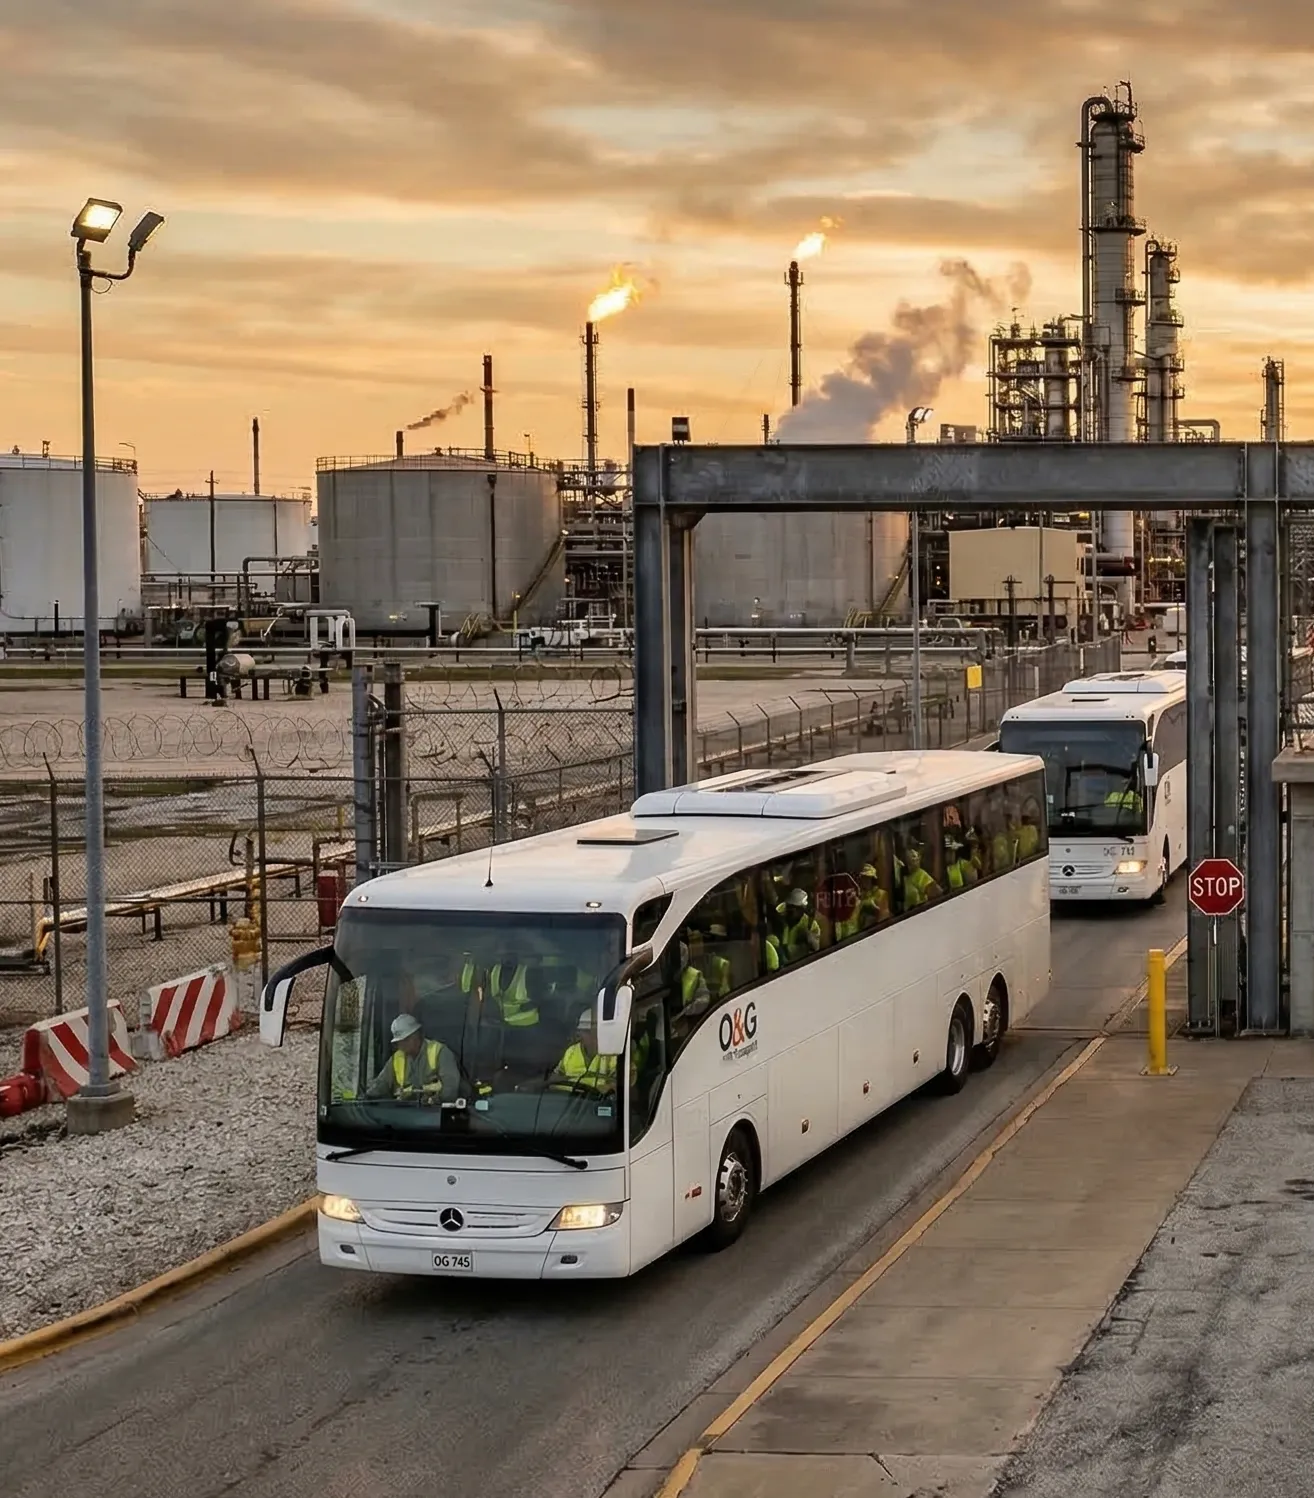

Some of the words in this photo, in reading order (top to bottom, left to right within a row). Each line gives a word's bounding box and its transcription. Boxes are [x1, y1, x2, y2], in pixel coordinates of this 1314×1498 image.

[1193, 877, 1240, 897] STOP
[719, 1001, 757, 1052] O&G
[434, 1255, 450, 1267] OG
[451, 1256, 470, 1268] 745
